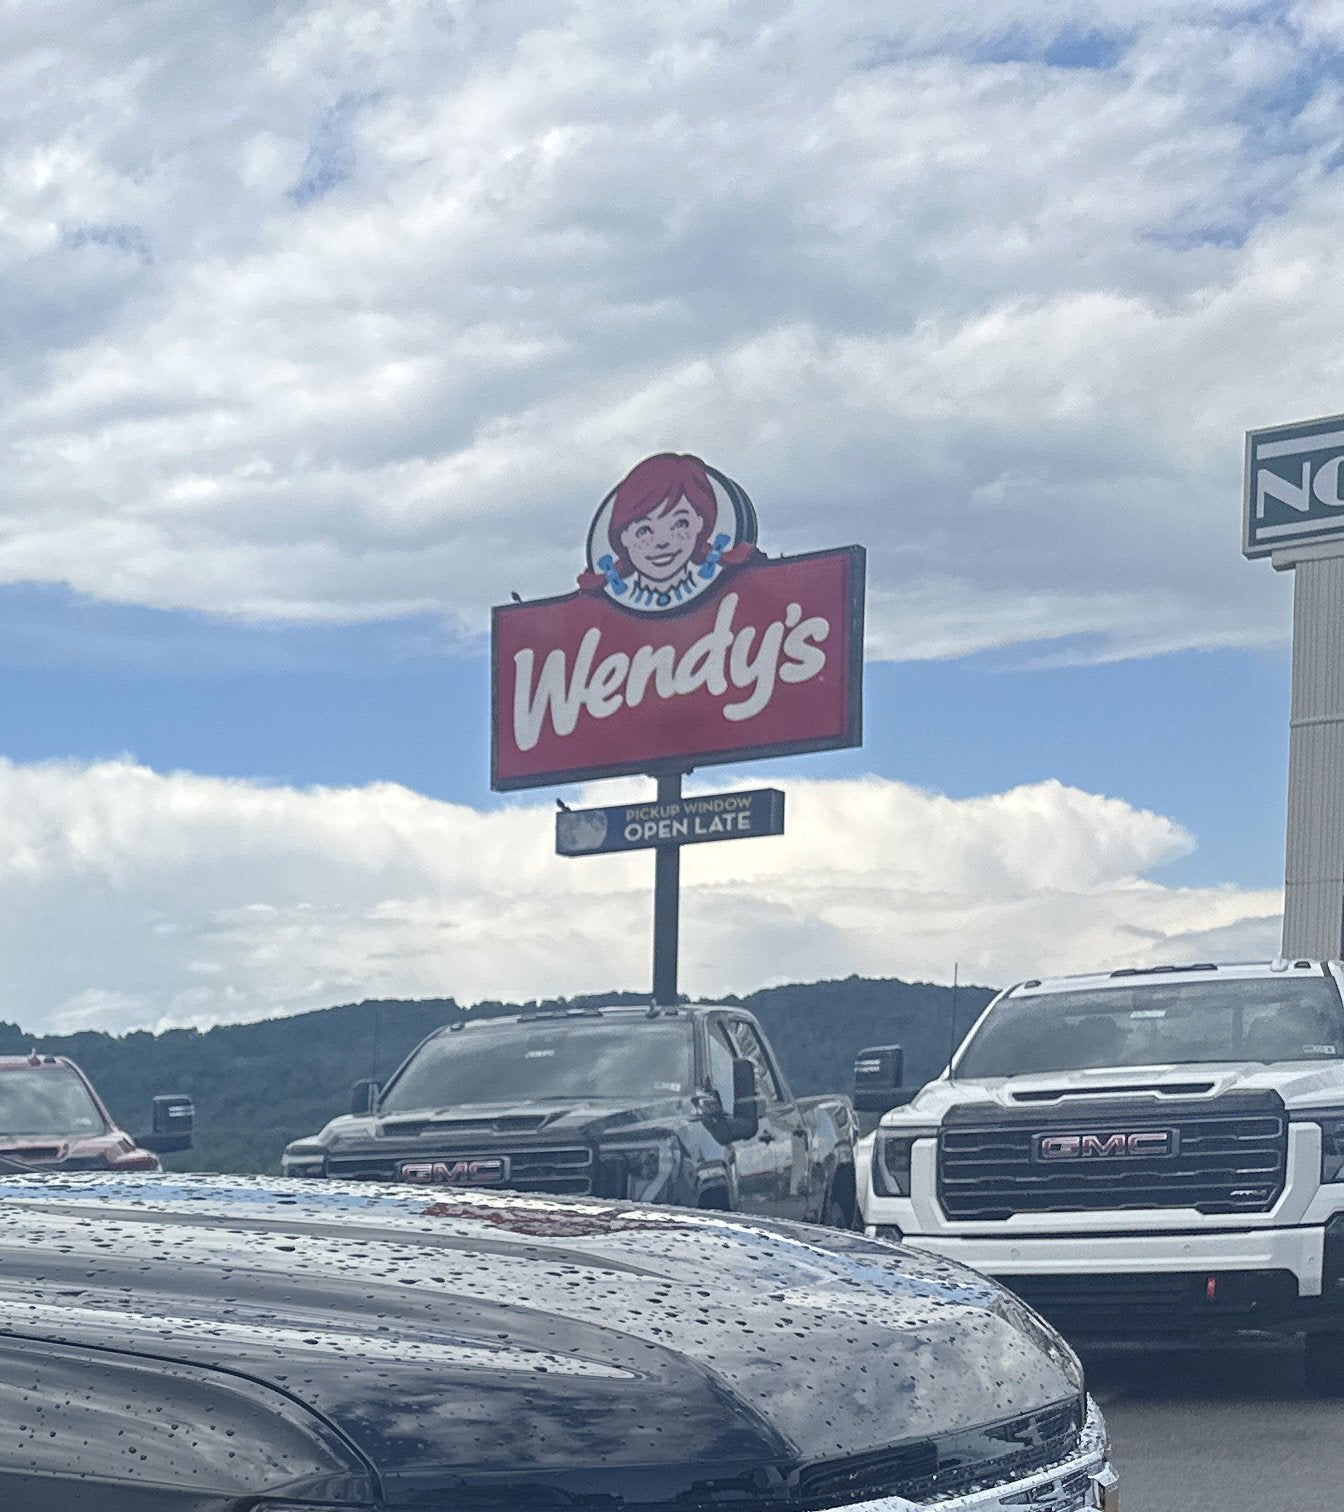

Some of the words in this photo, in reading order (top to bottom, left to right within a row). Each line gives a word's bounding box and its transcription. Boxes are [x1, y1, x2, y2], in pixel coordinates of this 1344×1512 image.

[513, 592, 830, 752] Wendy's
[625, 804, 681, 822] PICKUP
[683, 796, 753, 814] WINDOW
[623, 817, 689, 842] OPEN
[694, 811, 752, 835] LATE
[1041, 1132, 1168, 1159] GMC
[402, 1160, 501, 1184] GMC
